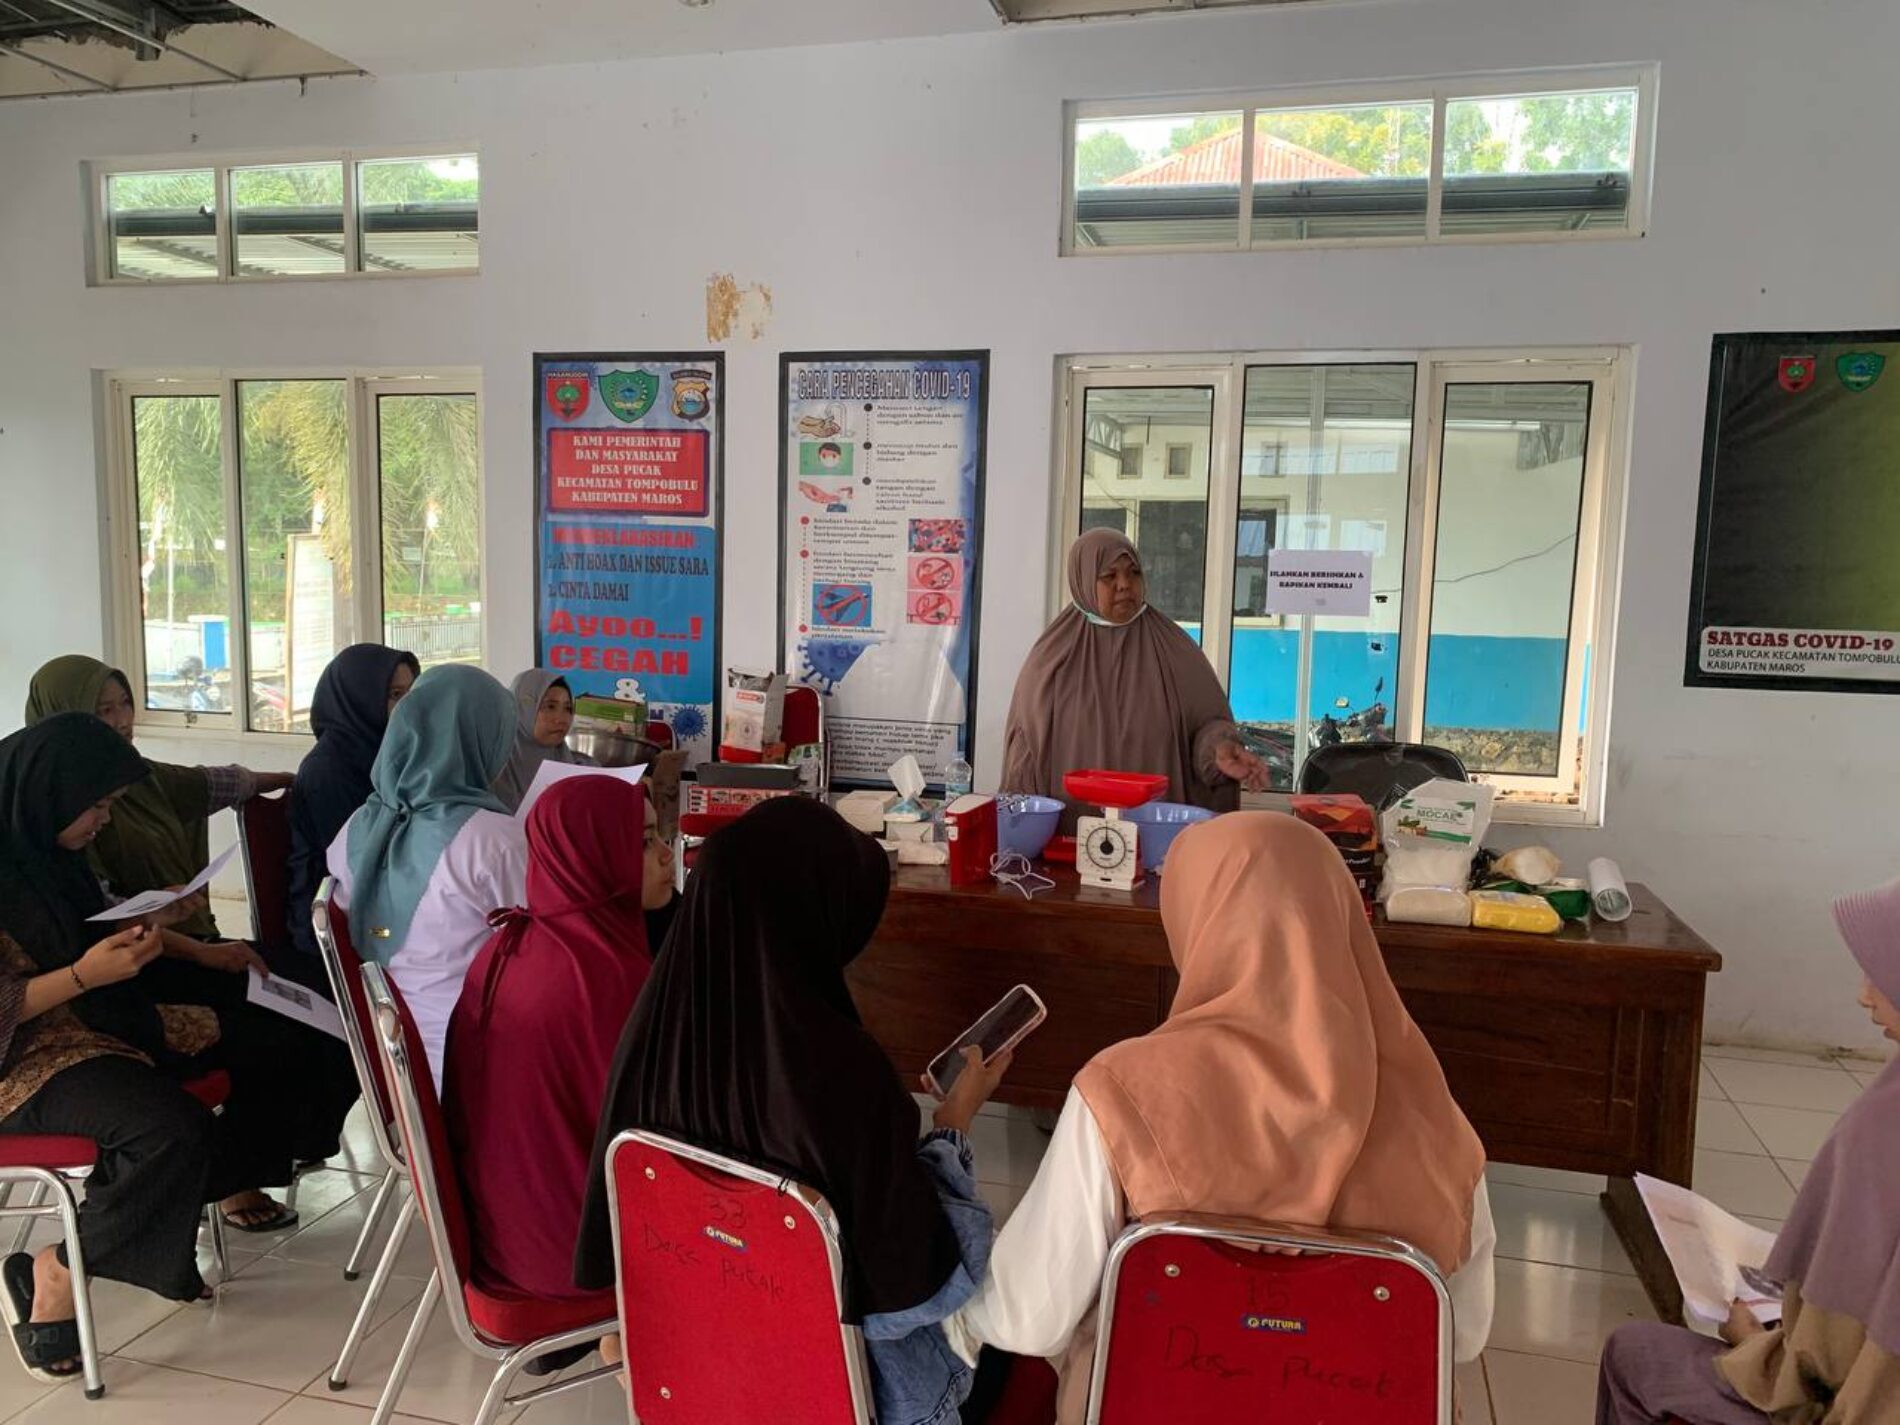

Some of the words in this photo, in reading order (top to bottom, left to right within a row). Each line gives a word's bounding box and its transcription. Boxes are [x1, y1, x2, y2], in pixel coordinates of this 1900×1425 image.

[832, 370, 909, 400] PENCEGAHAN
[913, 370, 971, 400] COVID-19
[573, 436, 602, 446] KAMI
[606, 436, 681, 447] PEMERINTAH
[576, 450, 599, 460] DAN
[603, 450, 678, 462] MASYARAKAT
[592, 464, 620, 475] DESA
[624, 464, 662, 476] PUCAK
[557, 477, 622, 488] KECAMATAN
[625, 479, 698, 491] TOMPOBULU
[572, 491, 638, 503] KABUPATEN
[641, 492, 682, 504] MAROS
[553, 528, 694, 548] EKLARASIKAN
[558, 552, 585, 569] ANTI
[587, 553, 616, 571] HOAX
[620, 555, 642, 572] DAN
[645, 556, 677, 574] ISSUE
[678, 557, 709, 576] SARA
[558, 581, 591, 600] CINTA
[593, 583, 629, 601] DAMAI
[1707, 631, 1789, 647] SATGAS
[1793, 634, 1894, 651] COVID-19
[550, 645, 689, 676] CEGAH
[1708, 649, 1733, 658] DESA
[1736, 650, 1770, 660] PUCAK
[1772, 652, 1836, 661] KECAMATAN
[1707, 661, 1767, 672] KABUPATEN
[1768, 664, 1806, 673] MAROS
[1261, 1318, 1303, 1332] FUTURA
